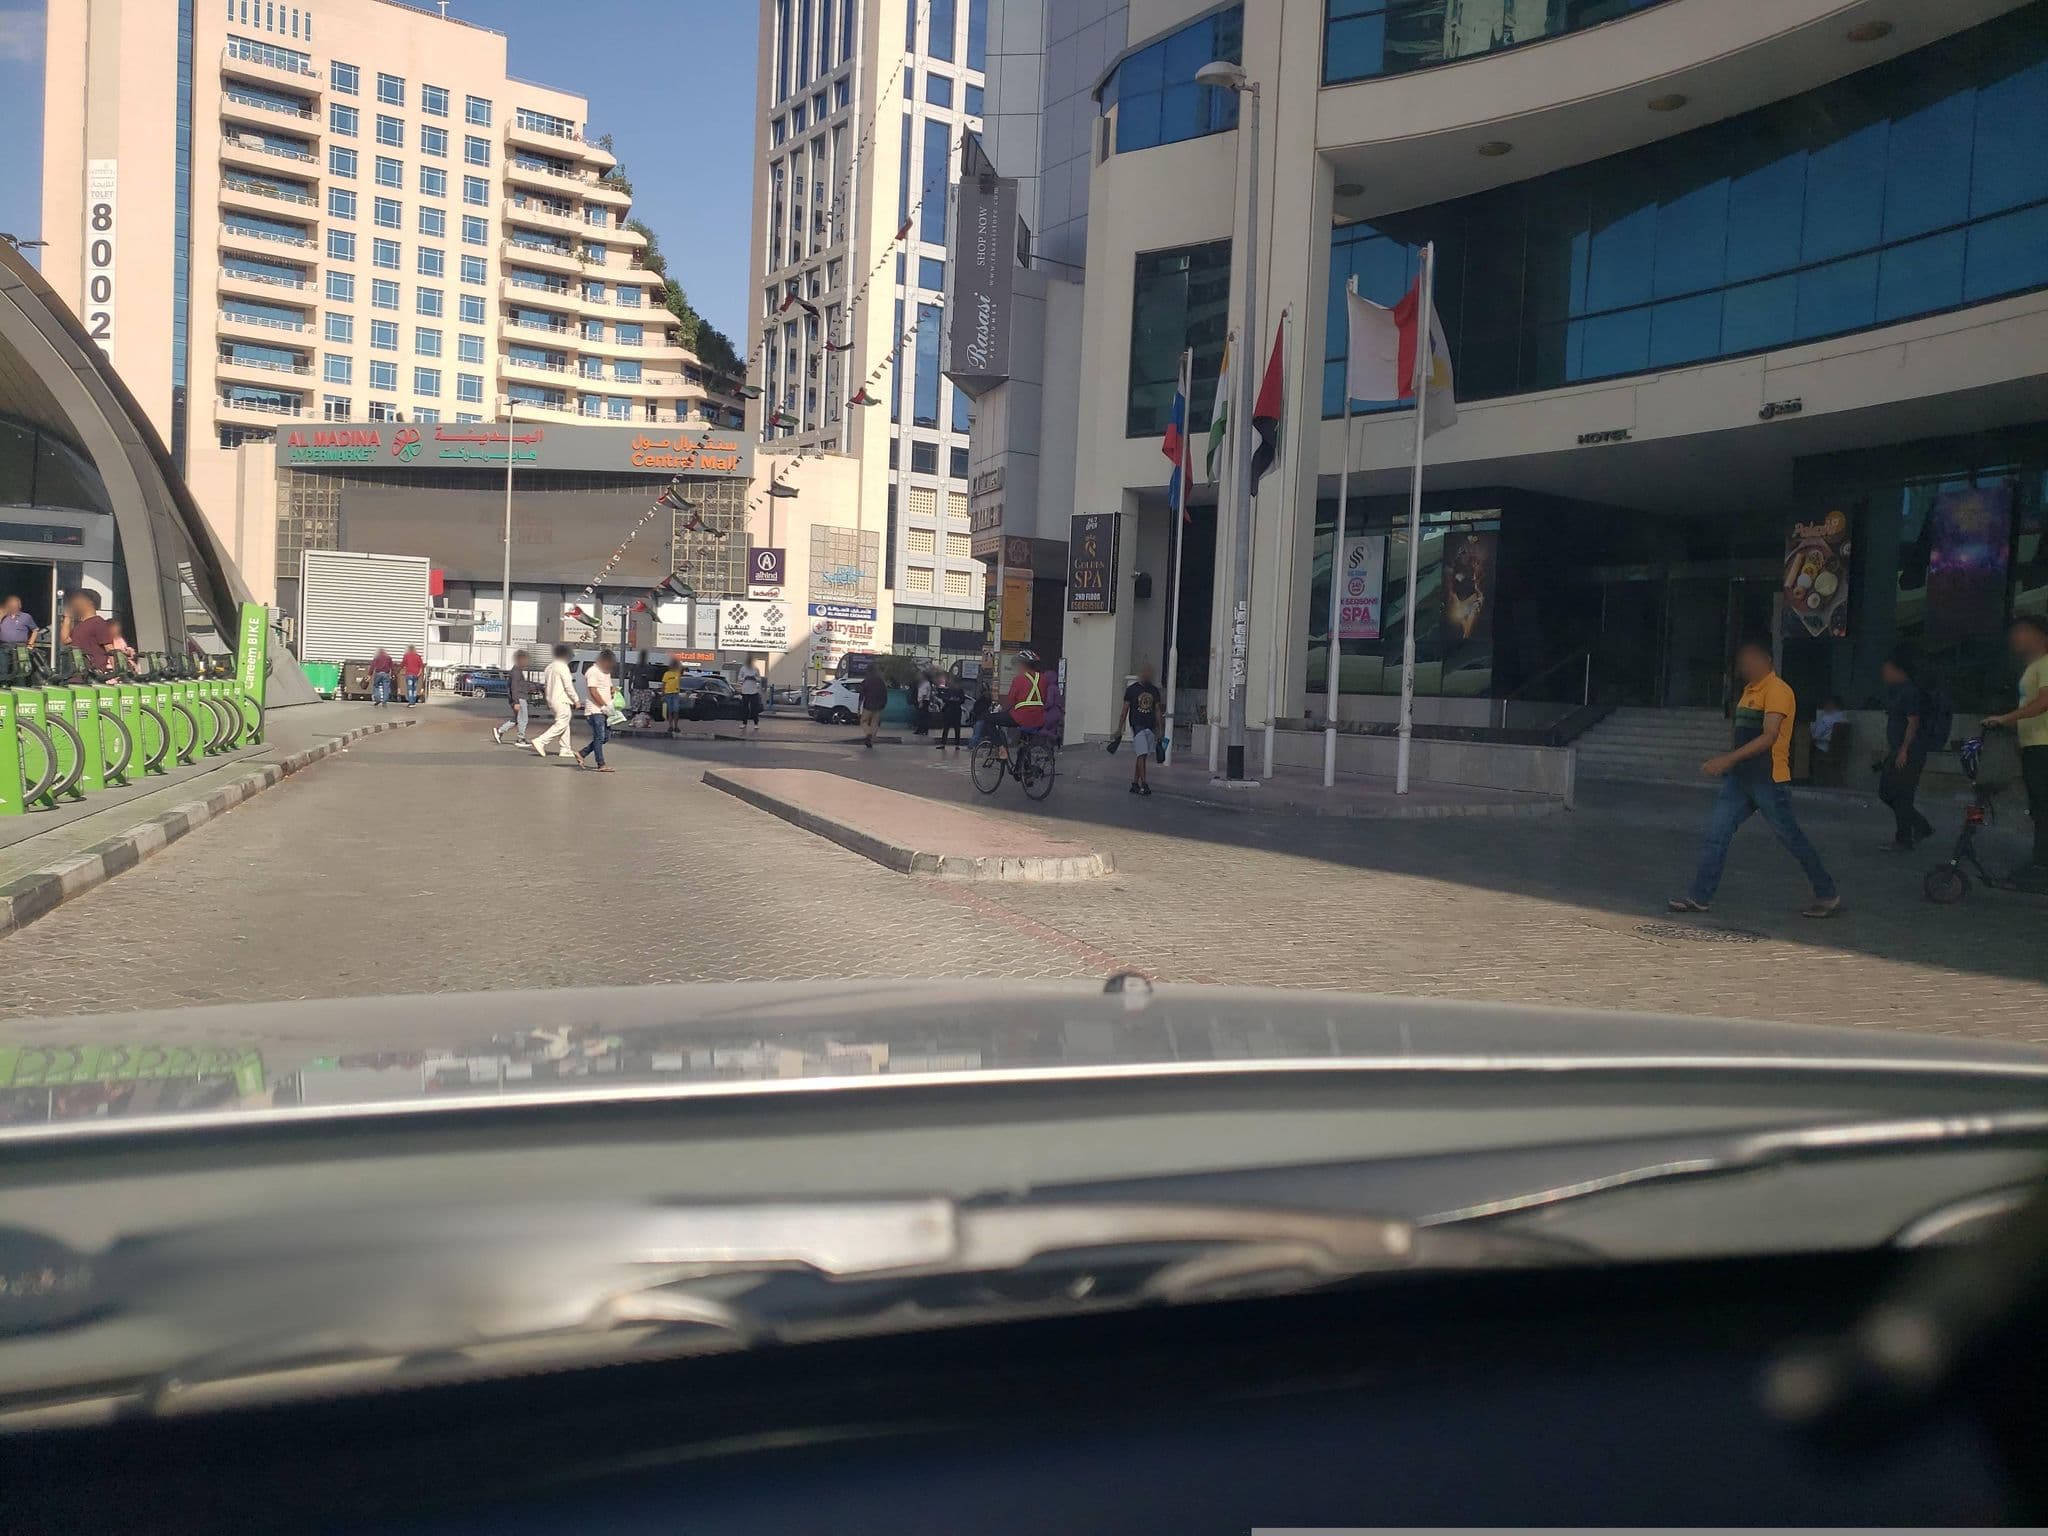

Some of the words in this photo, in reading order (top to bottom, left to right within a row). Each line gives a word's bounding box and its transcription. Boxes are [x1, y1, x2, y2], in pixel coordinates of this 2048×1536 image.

[978, 206, 988, 234] NOW
[977, 236, 986, 266] SHOP
[966, 292, 991, 370] Rasasi
[288, 430, 310, 447] AL
[312, 429, 382, 447] MADINA
[1577, 428, 1633, 444] HOTEL
[289, 447, 378, 462] HYPERMARKET
[631, 451, 694, 469] Central
[701, 454, 737, 472] Mall
[1074, 570, 1103, 589] SPA
[1342, 607, 1370, 622] SPA
[247, 617, 260, 645] BIKE
[826, 620, 874, 636] Biryanis
